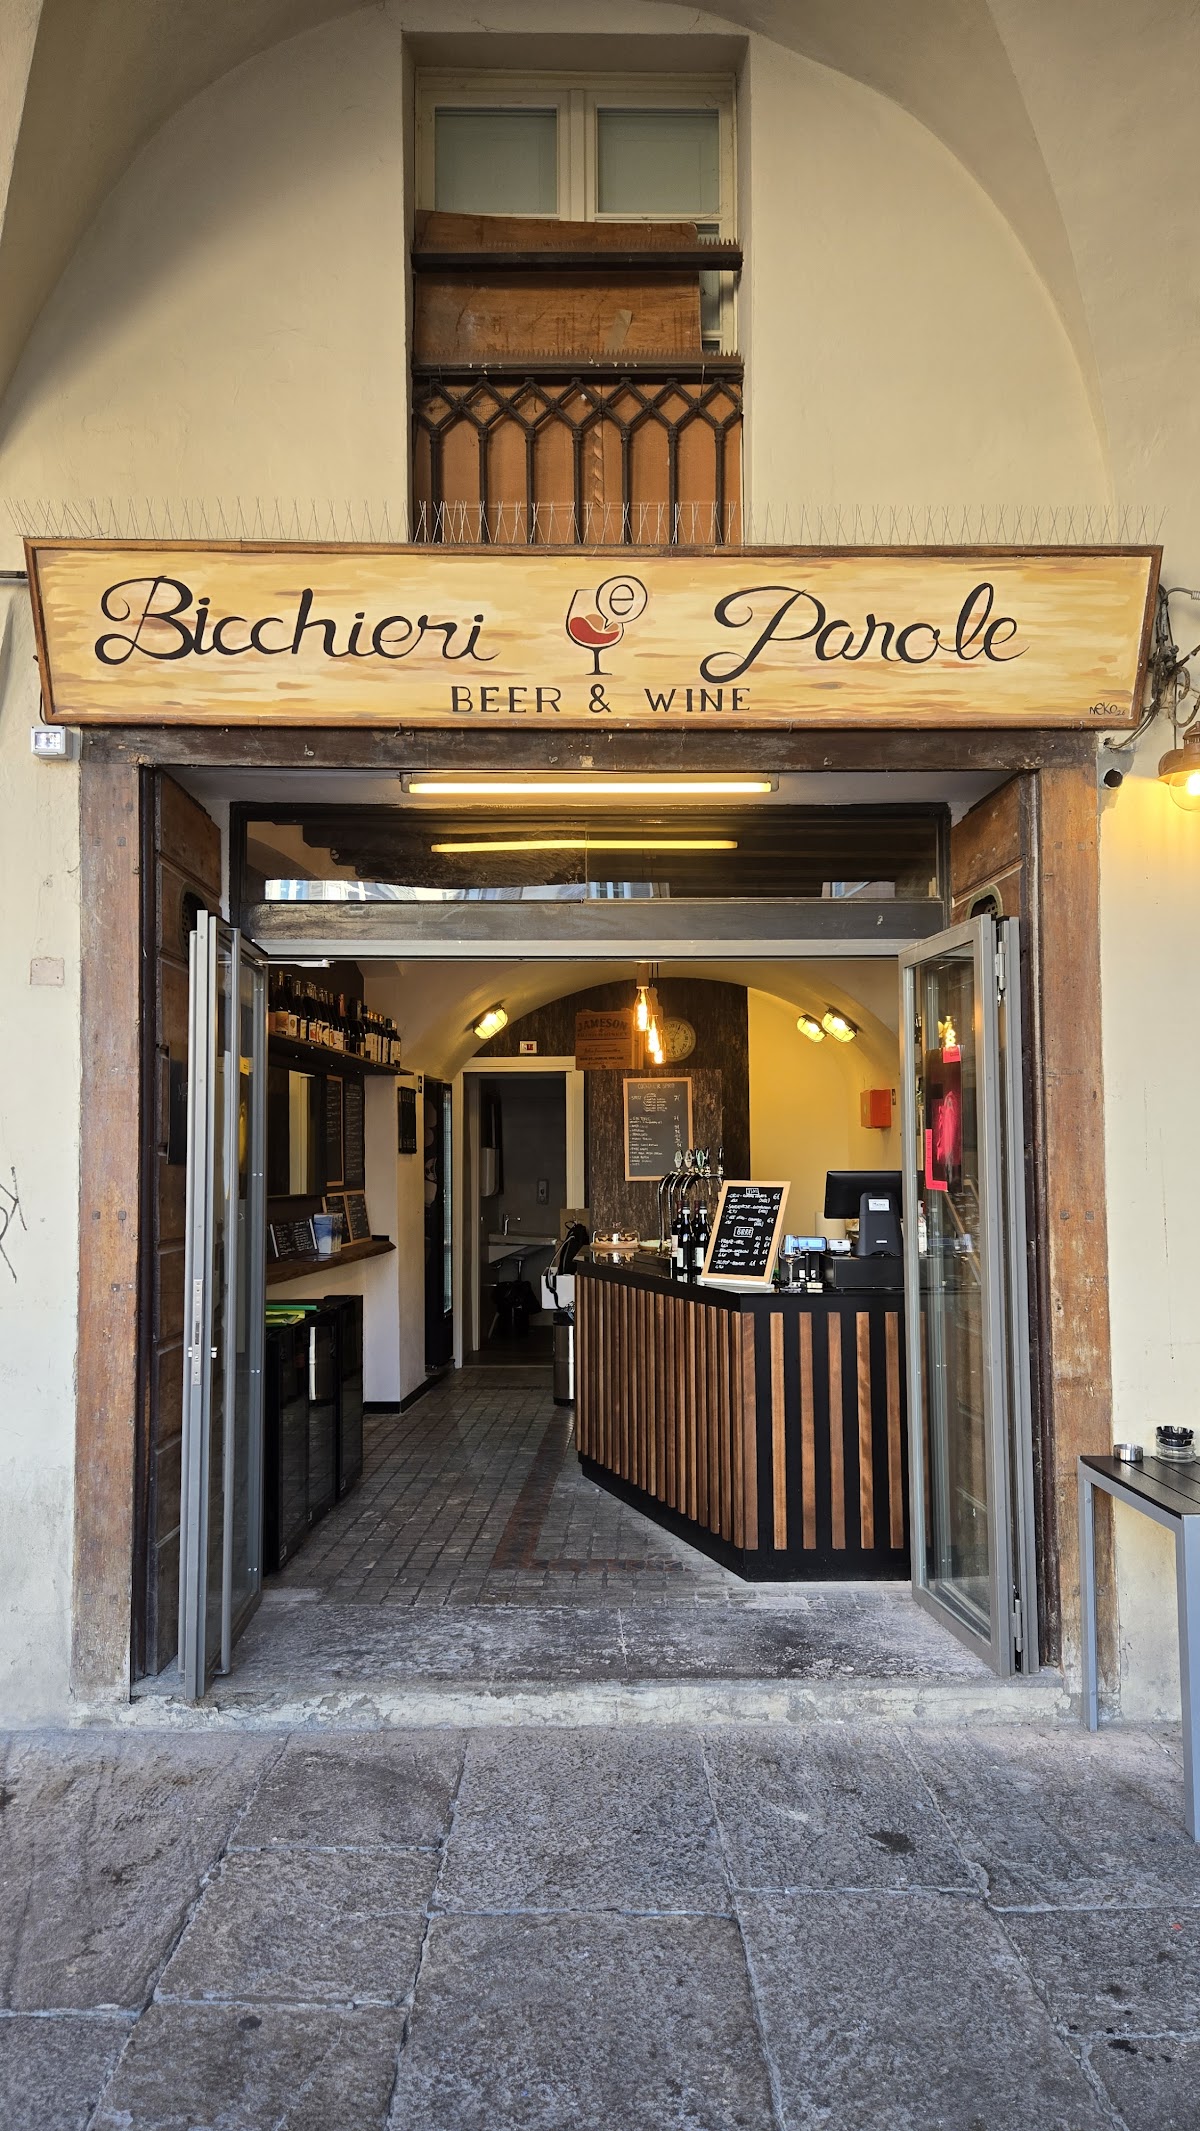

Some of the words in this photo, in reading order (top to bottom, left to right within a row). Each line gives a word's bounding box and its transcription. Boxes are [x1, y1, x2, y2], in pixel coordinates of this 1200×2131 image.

[95, 576, 500, 665] Bicchieri
[609, 584, 637, 615] e
[700, 583, 1028, 684] Parole
[451, 686, 561, 713] BEER
[589, 684, 613, 713] &
[644, 688, 751, 713] WINE
[577, 1018, 628, 1032] JAMESON
